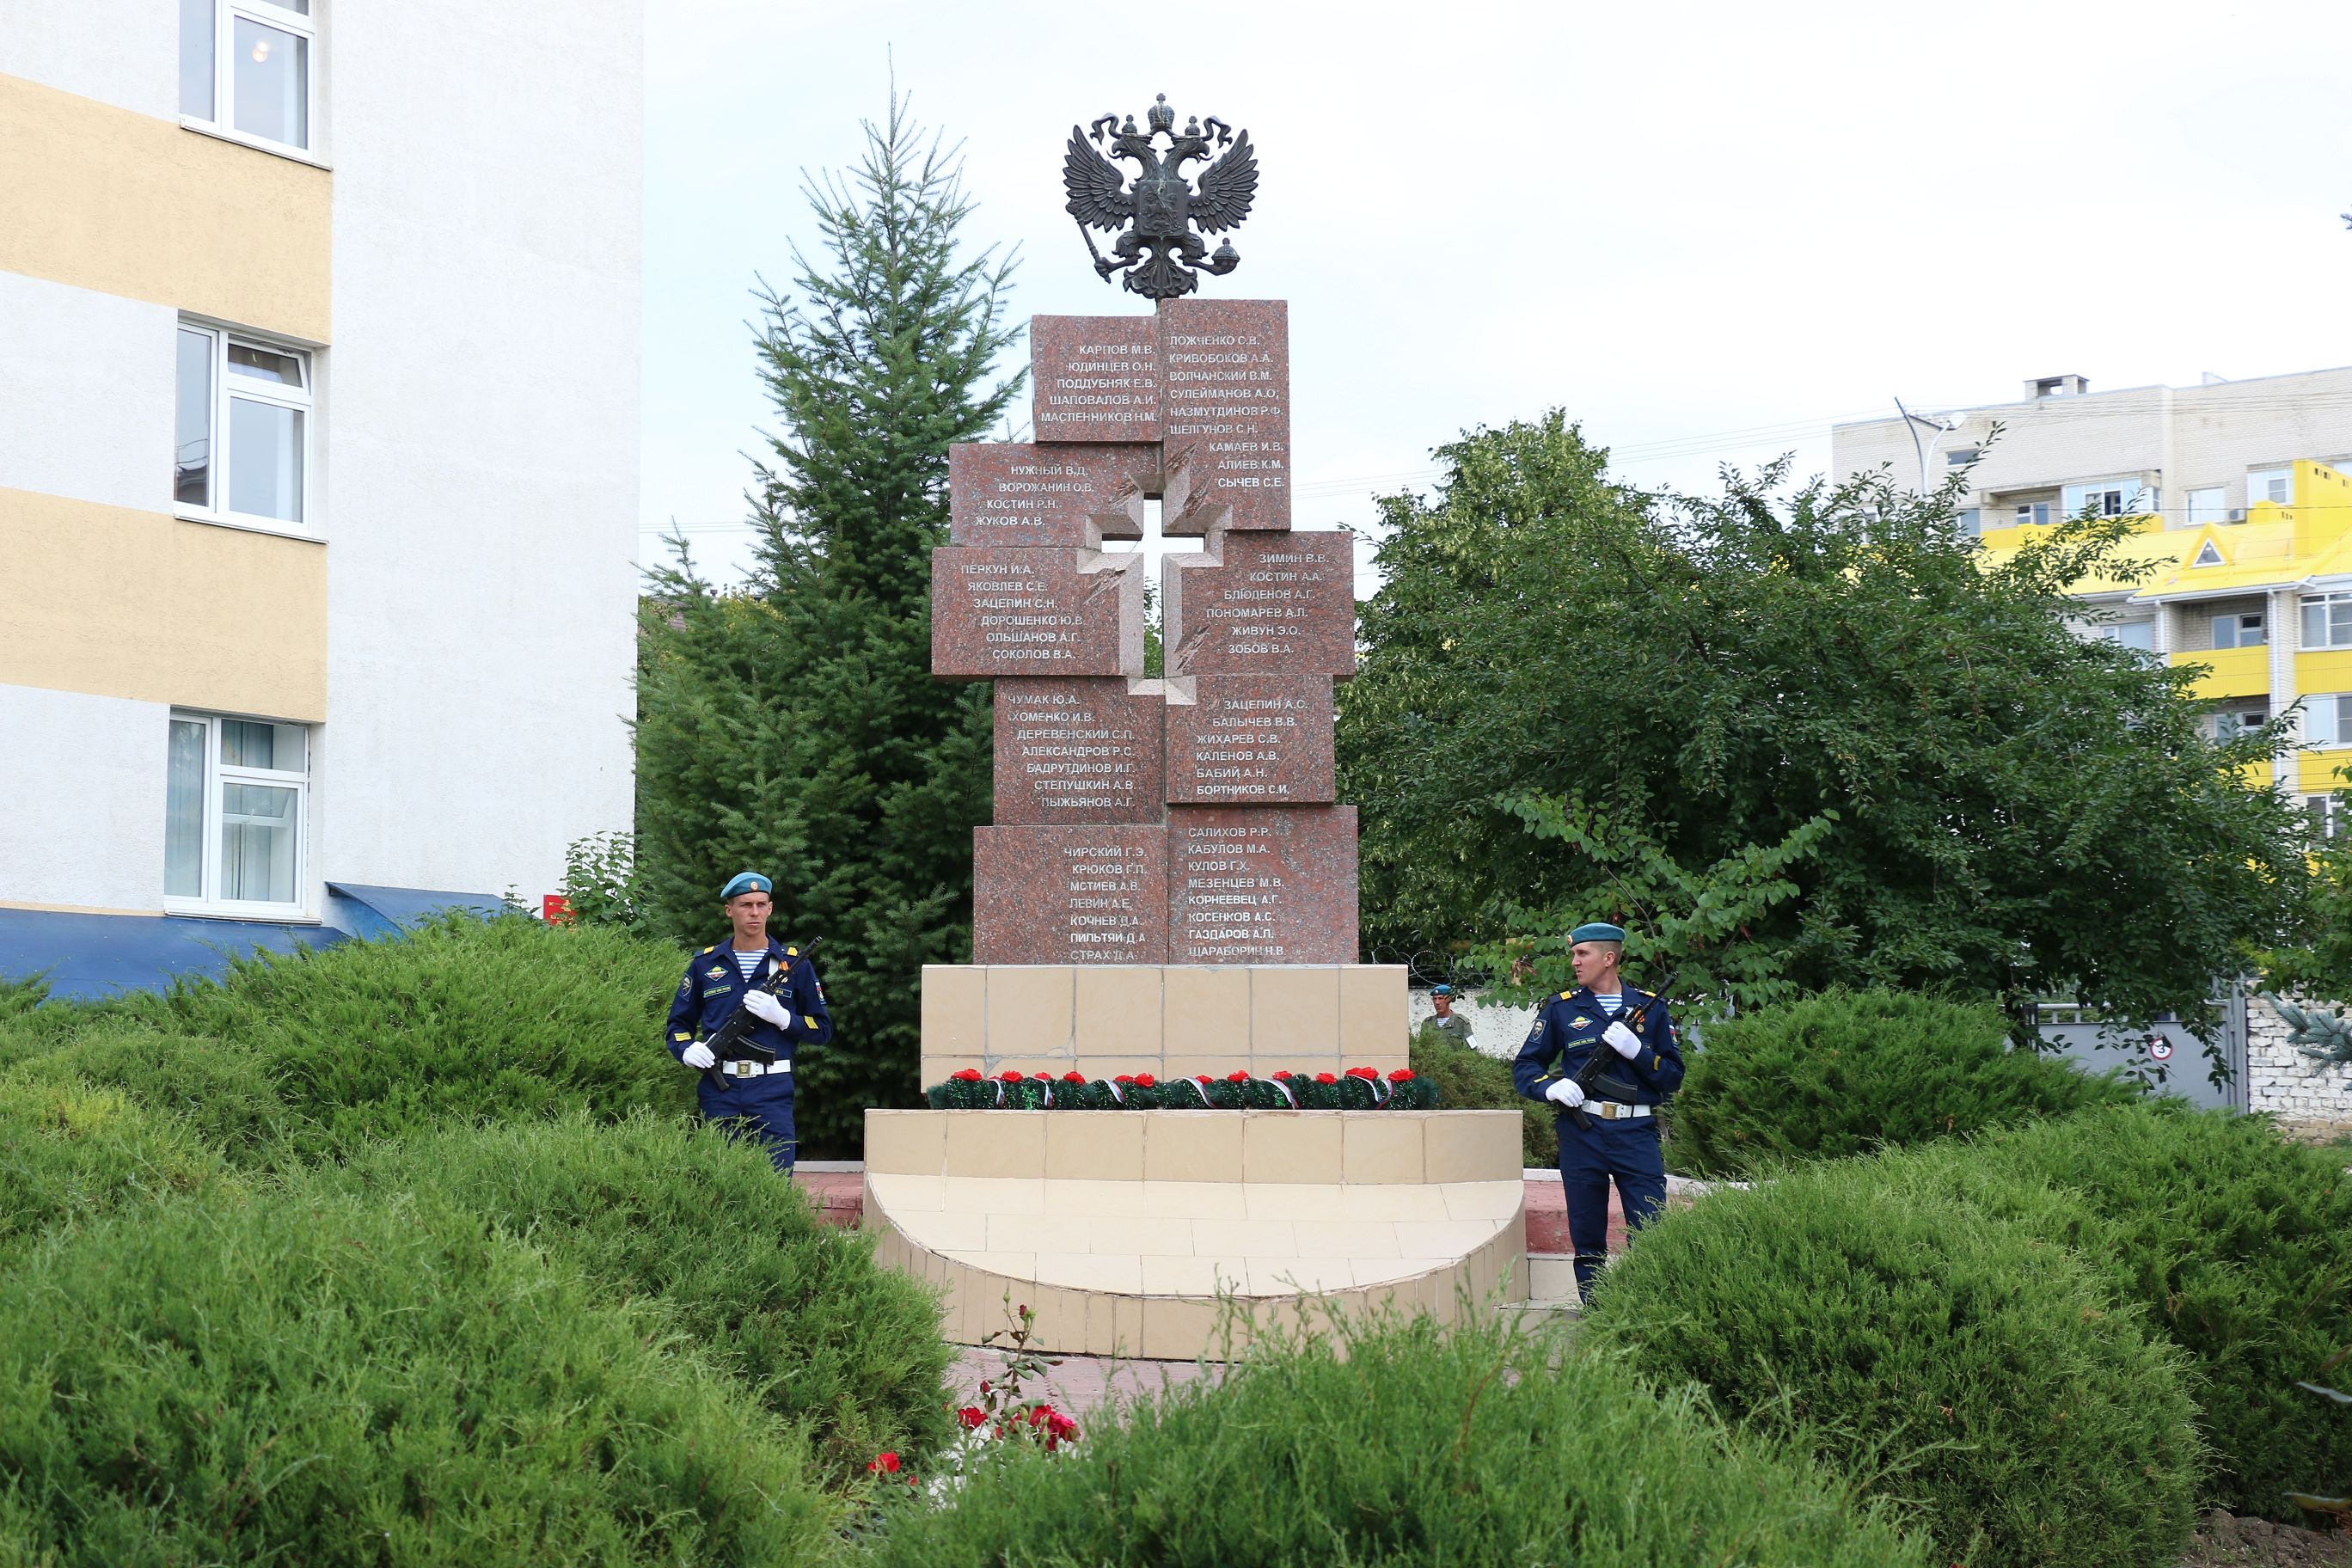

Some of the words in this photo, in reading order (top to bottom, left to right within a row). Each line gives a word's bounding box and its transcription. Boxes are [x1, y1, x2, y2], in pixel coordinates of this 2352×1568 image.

[1238, 336, 1259, 345] С.В.
[1080, 346, 1128, 354] КАРПОВ
[1131, 346, 1155, 354] М.В.
[1170, 354, 1247, 363] КРИВОБОКОВ
[1251, 354, 1273, 363] А.А.
[1068, 363, 1129, 372] ЮДИНЦЕВ
[1132, 363, 1155, 371] О.Н.
[1250, 371, 1272, 380] В.М.
[1057, 379, 1130, 389] ПОДДУБНЯК
[1134, 379, 1156, 388] Е.В.
[1170, 388, 1251, 399] СУЛЕЙМАНОВ
[1050, 395, 1130, 404] ШАПОВАЛОВ
[1133, 395, 1156, 404] А.И.
[1170, 407, 1258, 417] НАЗМУТДИНОВ
[1260, 407, 1283, 416] Р.Ф.
[1041, 413, 1131, 422] МАСЛЕННИКОВ
[1170, 425, 1233, 434] ШЕЛГУНОВ
[1210, 443, 1257, 451] КАМАЕВ
[1261, 442, 1283, 451] И.В.
[1218, 461, 1258, 469] АЛИЕВ
[1218, 478, 1259, 487] СЫЧЕВ
[1264, 478, 1284, 487] С.Е.
[999, 483, 1069, 492] ВОРОЖАНИН
[1074, 483, 1094, 492] О.В.
[976, 517, 1017, 525] ЖУКОВ
[1021, 517, 1044, 525] А.В.
[1259, 554, 1302, 563] ЗИМИН
[1306, 554, 1329, 563] В.В.
[1250, 573, 1296, 581] КОСТИН
[968, 582, 1023, 591] ЯКОВЛЕВ
[1026, 582, 1048, 591] С.Е.
[1224, 590, 1290, 600] БЛЮДЕНОВ
[973, 599, 1031, 609] ЗАЦЕПИН
[1206, 609, 1282, 618] ПОНОМАРЕВ
[981, 616, 1057, 627] ДОРОШЕНКО
[1232, 627, 1273, 635] ЖИВУН
[1277, 627, 1301, 635] Э.О.
[986, 633, 1056, 642] ОЛЬШАНОВ
[1228, 645, 1268, 653] ЗОБОВ
[1272, 645, 1294, 653] В.А.
[993, 650, 1050, 659] СОКОЛОВ
[1008, 695, 1049, 704] ЧУМАК
[1053, 695, 1080, 704] Ю.А.
[1224, 701, 1281, 711] ЗАЦЕПИН
[1284, 700, 1308, 709] А.С.
[1012, 713, 1069, 721] ХОМЕНКО
[1073, 713, 1094, 721] И.В.
[1213, 718, 1271, 726] БАЛЫЧЕВ
[1276, 717, 1297, 726] В.В.
[1197, 734, 1254, 744] ЖИХАРЕВ
[1259, 734, 1280, 744] С.В.
[1022, 747, 1109, 756] АЛЕКСАНДРОВ
[1197, 751, 1253, 761] КАЛЕНОВ
[1257, 751, 1279, 761] А.В.
[1026, 764, 1112, 774] БАДРУТДИНОВ
[1197, 766, 1240, 778] БАБИЙ
[1244, 769, 1267, 777] А.Н.
[1035, 781, 1109, 790] СТЕПУШКИН
[1113, 781, 1136, 789] А.В.
[1197, 785, 1265, 794] БОРТНИКОВ
[1188, 828, 1246, 836] САЛИХОВ
[1250, 828, 1271, 836] Р.Р.
[1188, 844, 1243, 854] КАБУЛОВ
[1246, 844, 1270, 853] М.А.
[1073, 865, 1122, 873] КРЮКОВ
[1188, 861, 1227, 871] КУЛОВ
[1230, 861, 1250, 870] Г.Х.
[1070, 882, 1116, 891] МСТИЕВ
[1188, 879, 1255, 888] МЕЗЕНЦЕВ
[1259, 879, 1284, 887] М.В.
[1069, 898, 1108, 908] ЛЕВИН
[1188, 896, 1256, 905] КОРНЕЕВЕЦ
[1070, 916, 1116, 926] КОЧНЕВ
[1188, 912, 1250, 922] КОСЕНКОВ
[1255, 912, 1275, 921] А.С.
[1189, 929, 1248, 940] ГАЗДАРОВ
[1253, 929, 1273, 939] А.Л.
[1071, 951, 1111, 959] СТРАХ
[1189, 946, 1262, 956] ШАРАБОРИН
